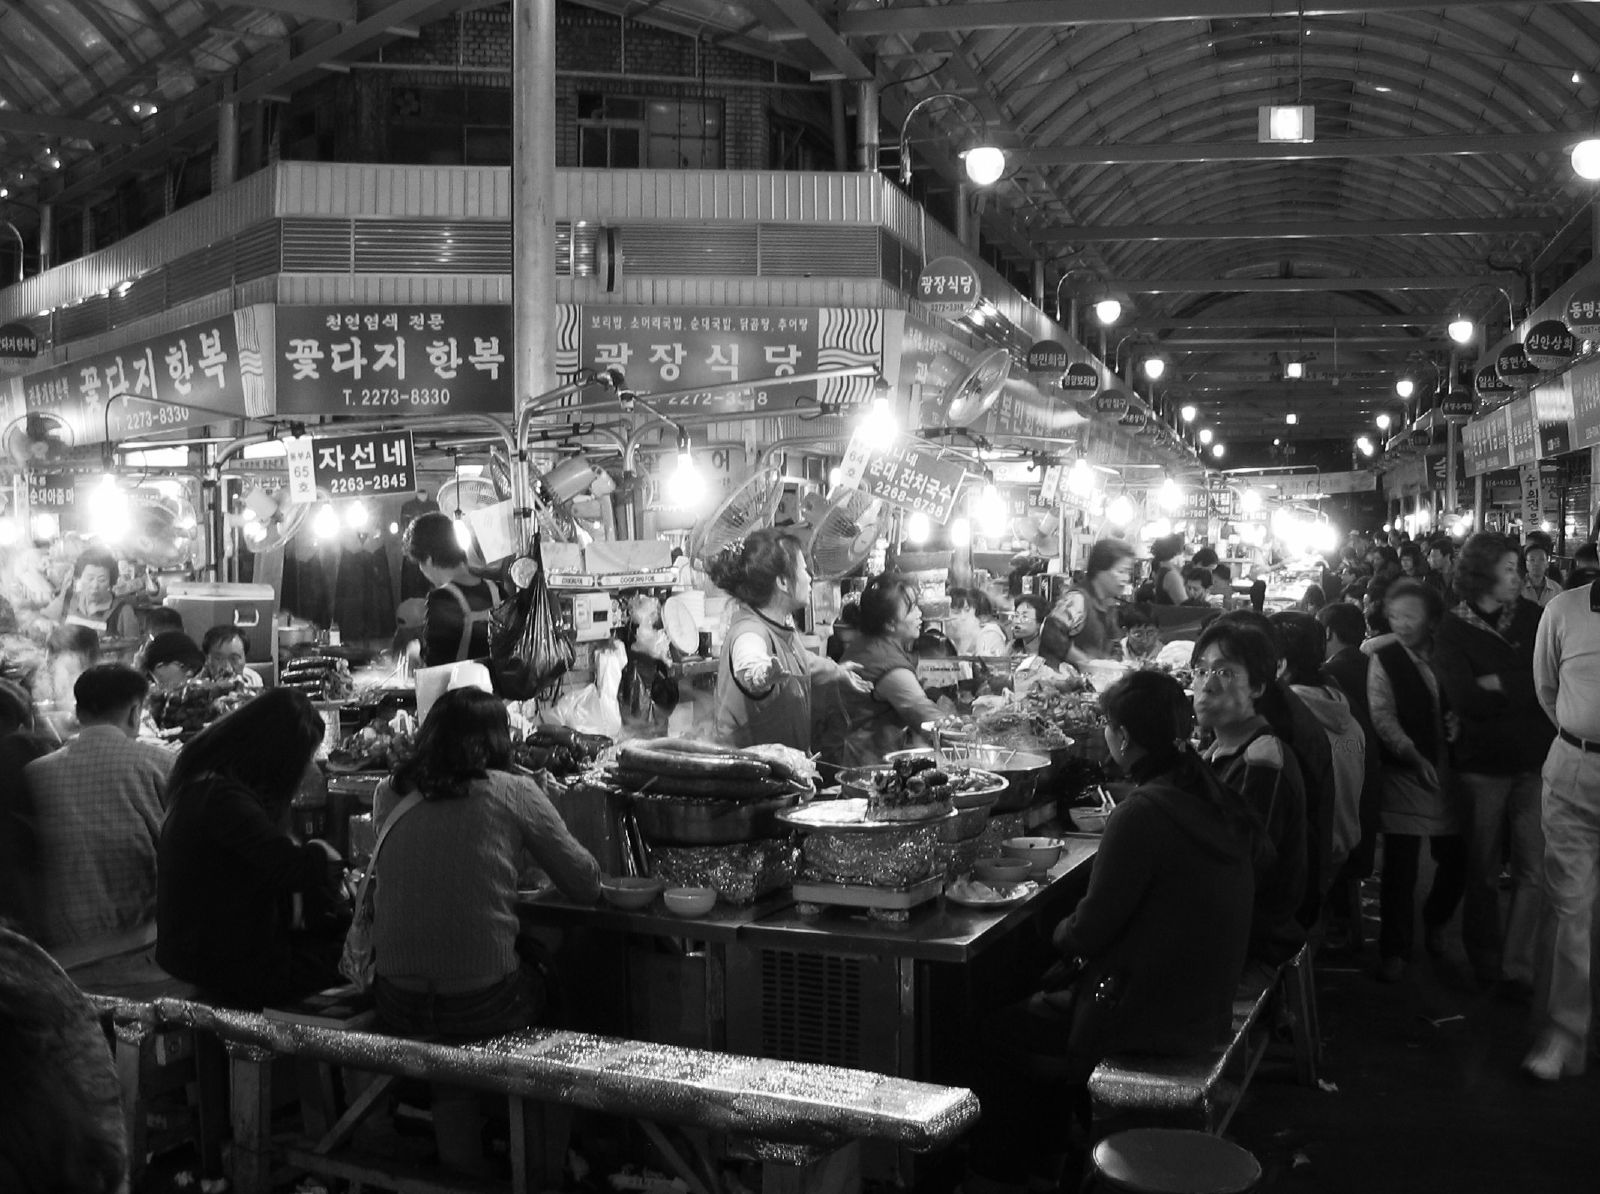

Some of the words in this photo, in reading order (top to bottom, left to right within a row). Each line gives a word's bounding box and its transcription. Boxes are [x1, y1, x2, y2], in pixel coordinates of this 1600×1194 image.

[920, 275, 974, 295] 광장식당
[326, 312, 399, 331] 천연염색
[409, 312, 446, 331] 전문
[1528, 334, 1574, 351] 신안상회
[285, 336, 406, 380] 꽃다지
[425, 336, 505, 380] 한복
[594, 342, 802, 382] 광장식당
[79, 346, 158, 410] 꽃다지
[164, 328, 228, 396] 한복
[342, 389, 357, 406] T.
[361, 388, 451, 406] 2273-8330
[126, 407, 190, 431] 2273-8330
[318, 439, 407, 472] 자선네
[294, 466, 310, 478] 65
[331, 473, 407, 493] 2263-2845
[30, 488, 75, 505] 순대아줌마
